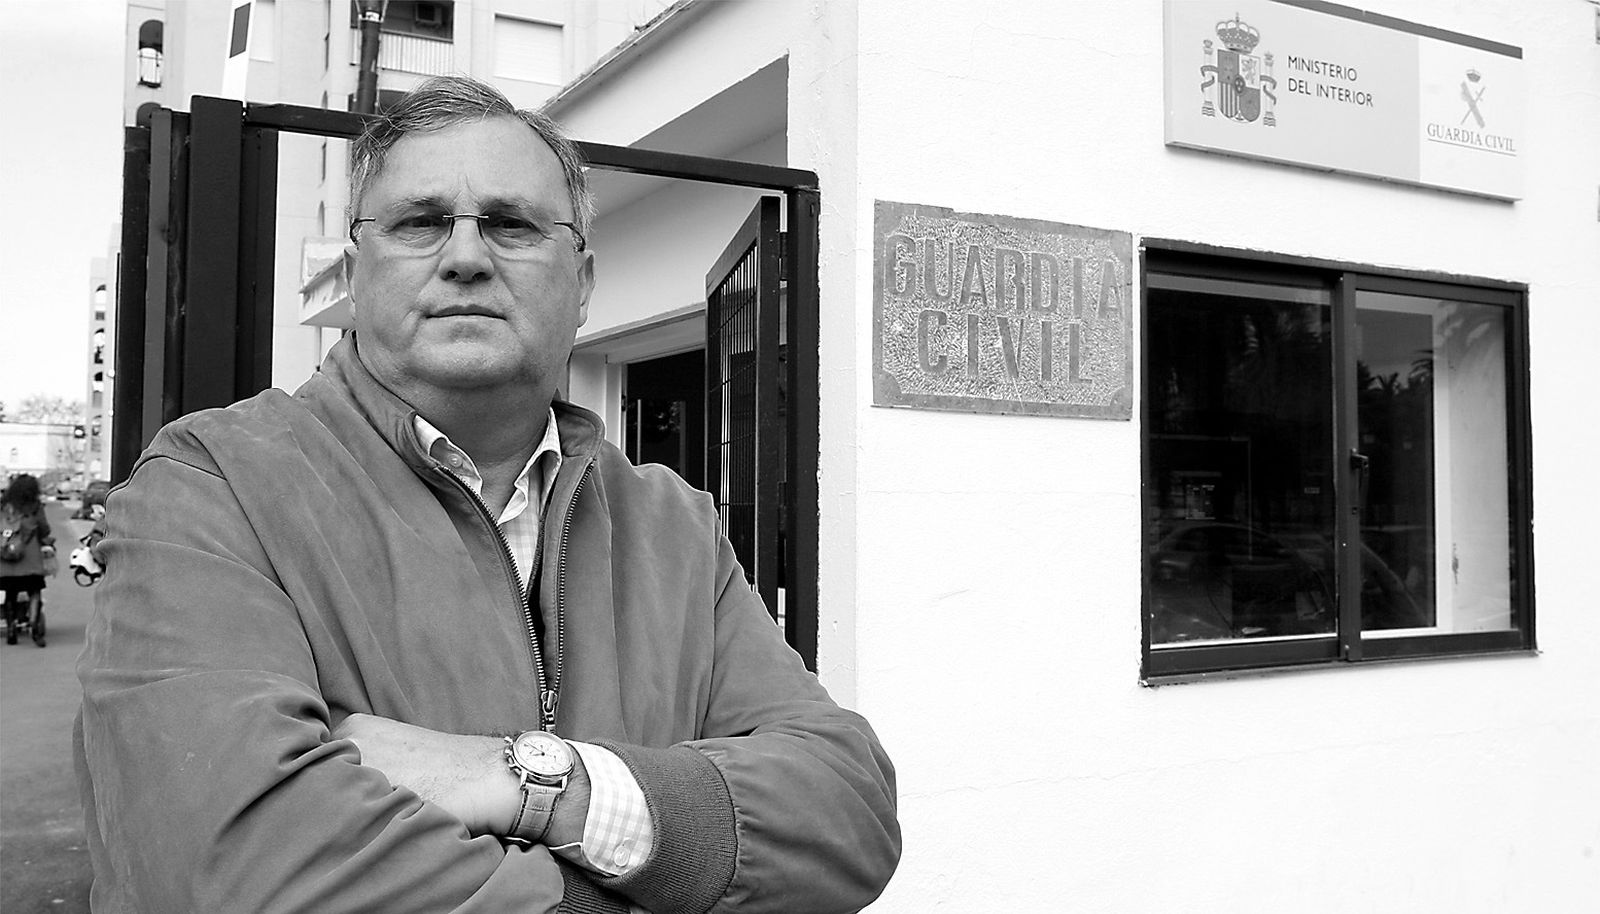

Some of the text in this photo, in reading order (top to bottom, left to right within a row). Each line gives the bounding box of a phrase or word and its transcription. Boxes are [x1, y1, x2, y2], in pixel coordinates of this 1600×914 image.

[1288, 55, 1357, 81] MINISTERIO
[1288, 77, 1373, 107] DEL INTERIOR
[1427, 122, 1516, 152] GUARDIA CIVIL
[885, 234, 1125, 319] GUARDIA
[918, 309, 1093, 384] CIVIL
